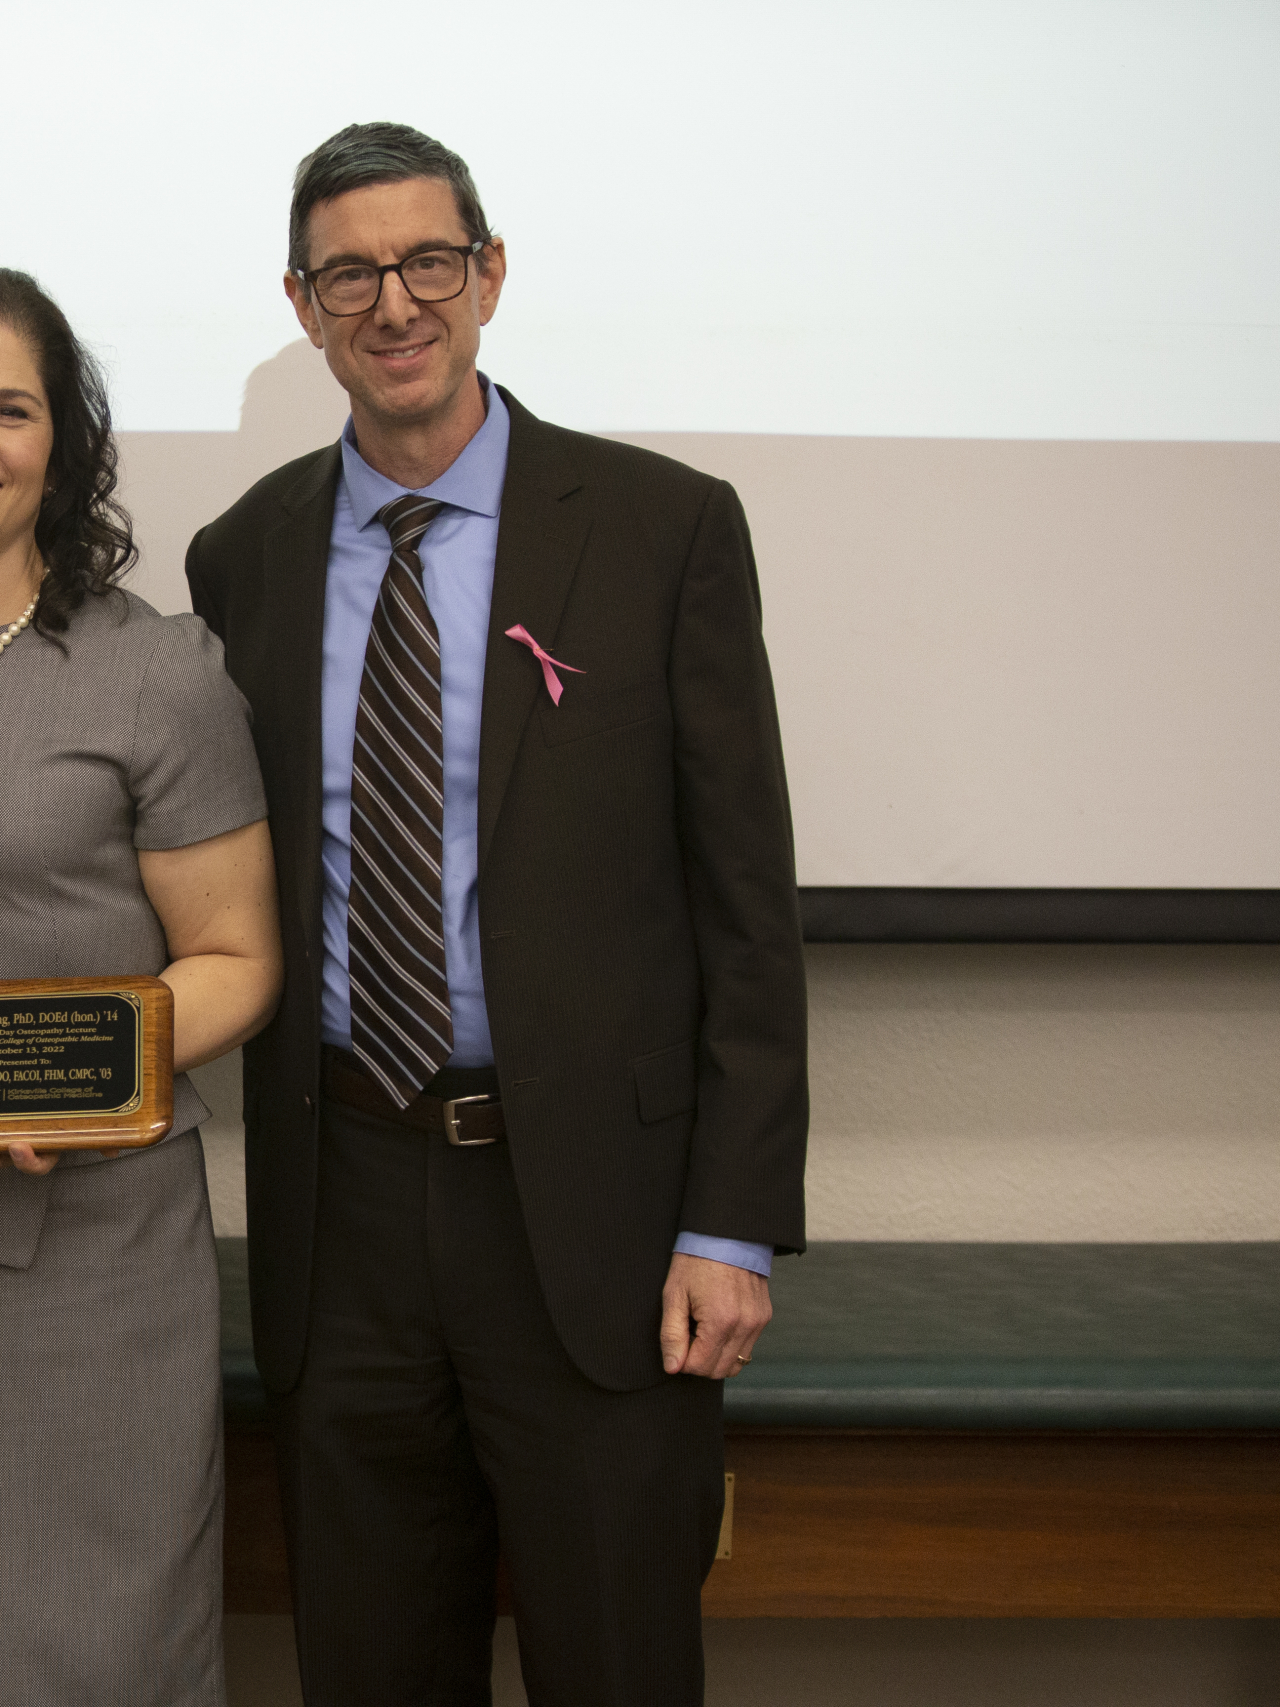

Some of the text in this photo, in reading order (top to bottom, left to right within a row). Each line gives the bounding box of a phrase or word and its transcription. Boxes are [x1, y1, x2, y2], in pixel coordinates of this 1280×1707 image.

[13, 1012, 36, 1025] PhD,
[38, 1011, 68, 1023] DOEd
[70, 1010, 100, 1025] (hon.)
[103, 1010, 118, 1020] '14
[16, 1027, 64, 1036] Osteopathy
[26, 1036, 35, 1045] of
[35, 1035, 79, 1044] Osteopathic
[26, 1046, 40, 1054] 13,
[13, 1070, 42, 1083] FACOI,
[44, 1069, 67, 1082] FHM,
[68, 1068, 97, 1081] CMPC,
[99, 1068, 112, 1080] '03
